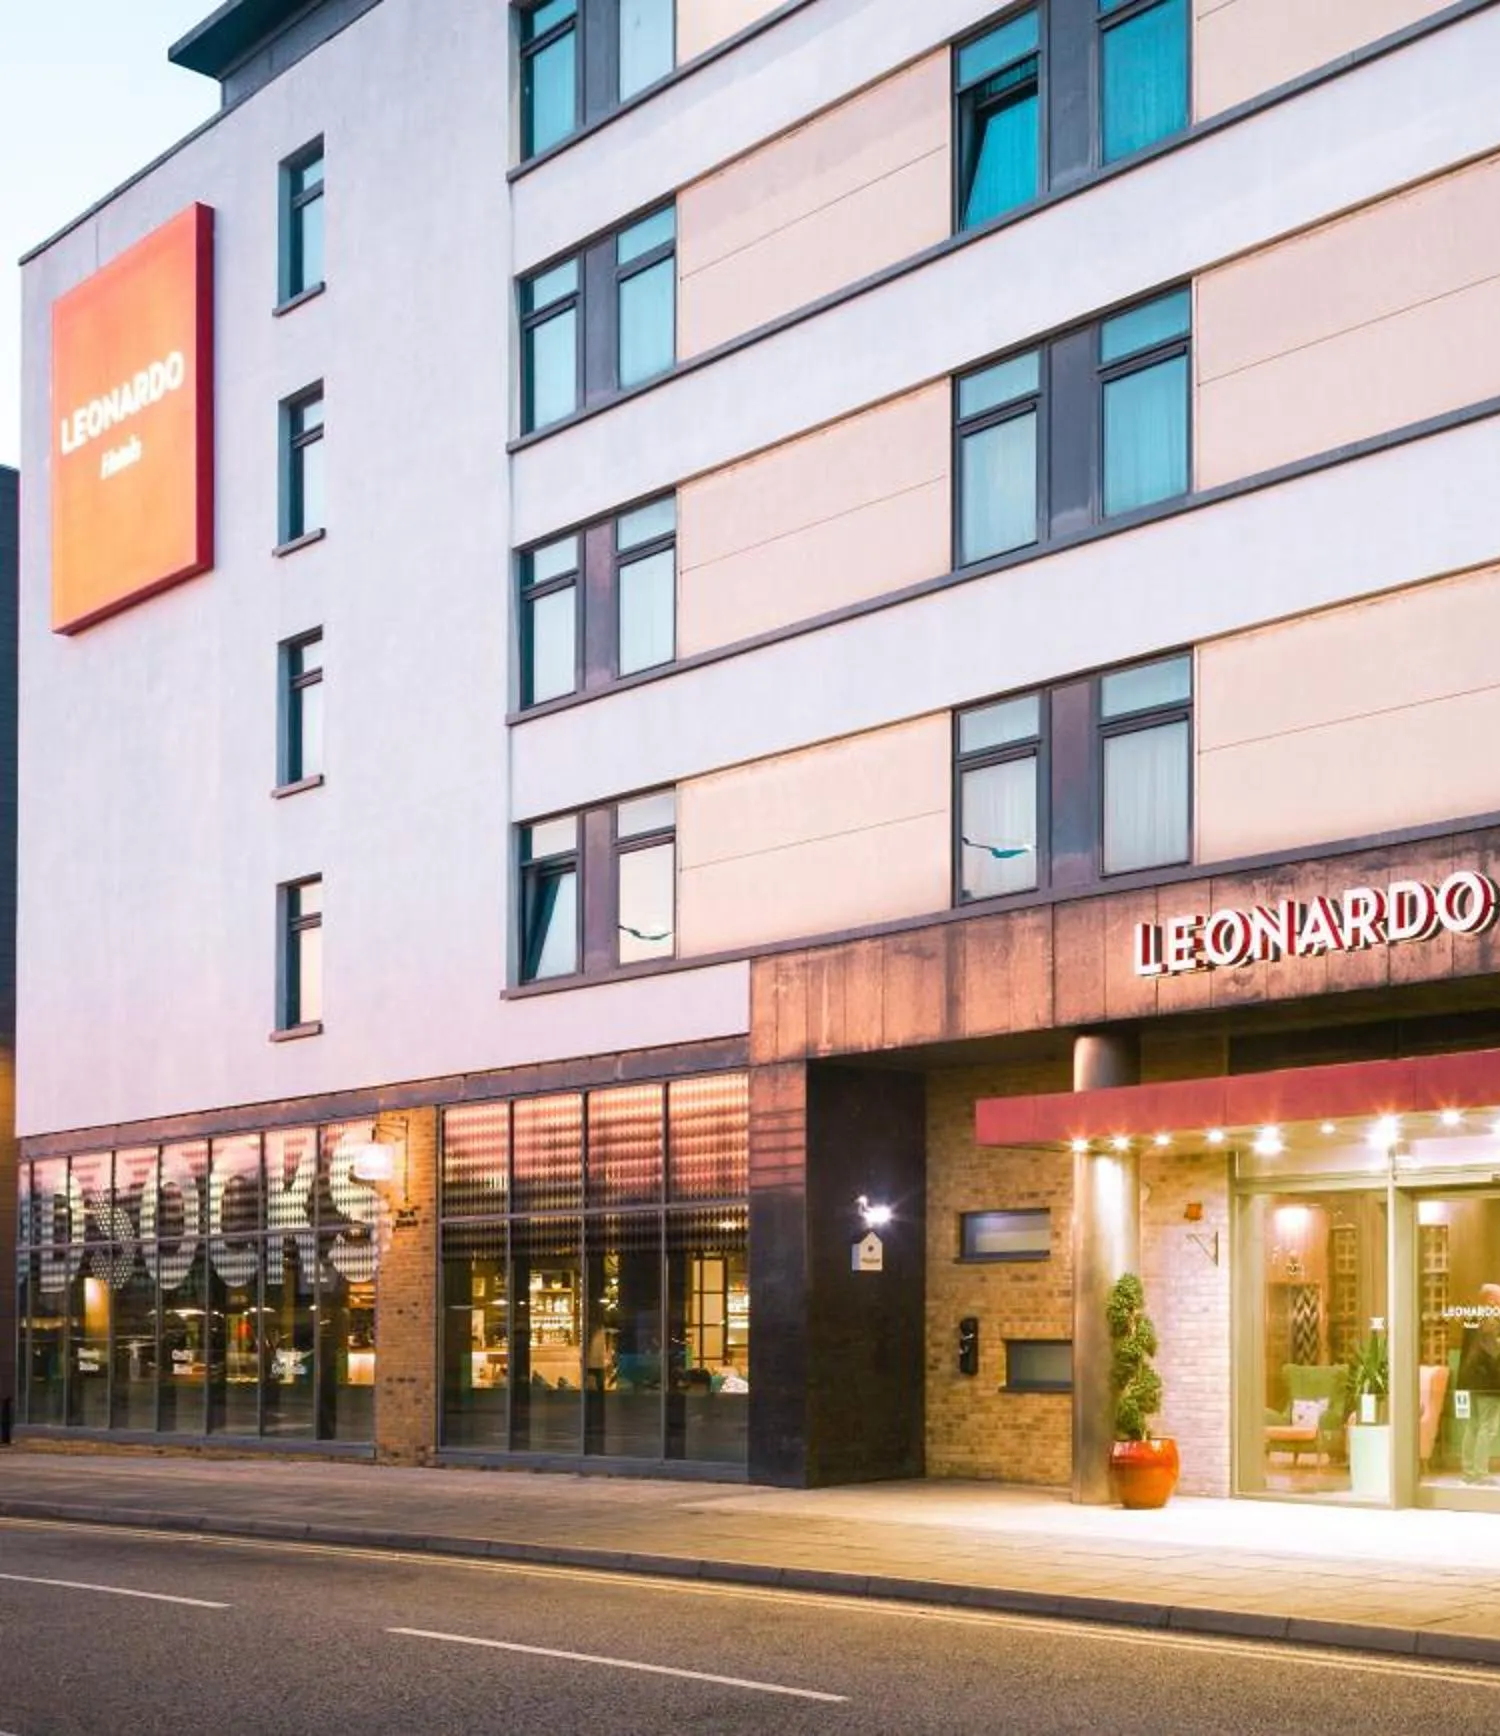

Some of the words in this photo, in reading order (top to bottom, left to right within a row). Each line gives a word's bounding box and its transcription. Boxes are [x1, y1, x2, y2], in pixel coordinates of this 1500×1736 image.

[60, 350, 184, 455] LEONARDO
[1134, 870, 1500, 977] LEONARDO
[1442, 1305, 1500, 1317] LEONARDO
